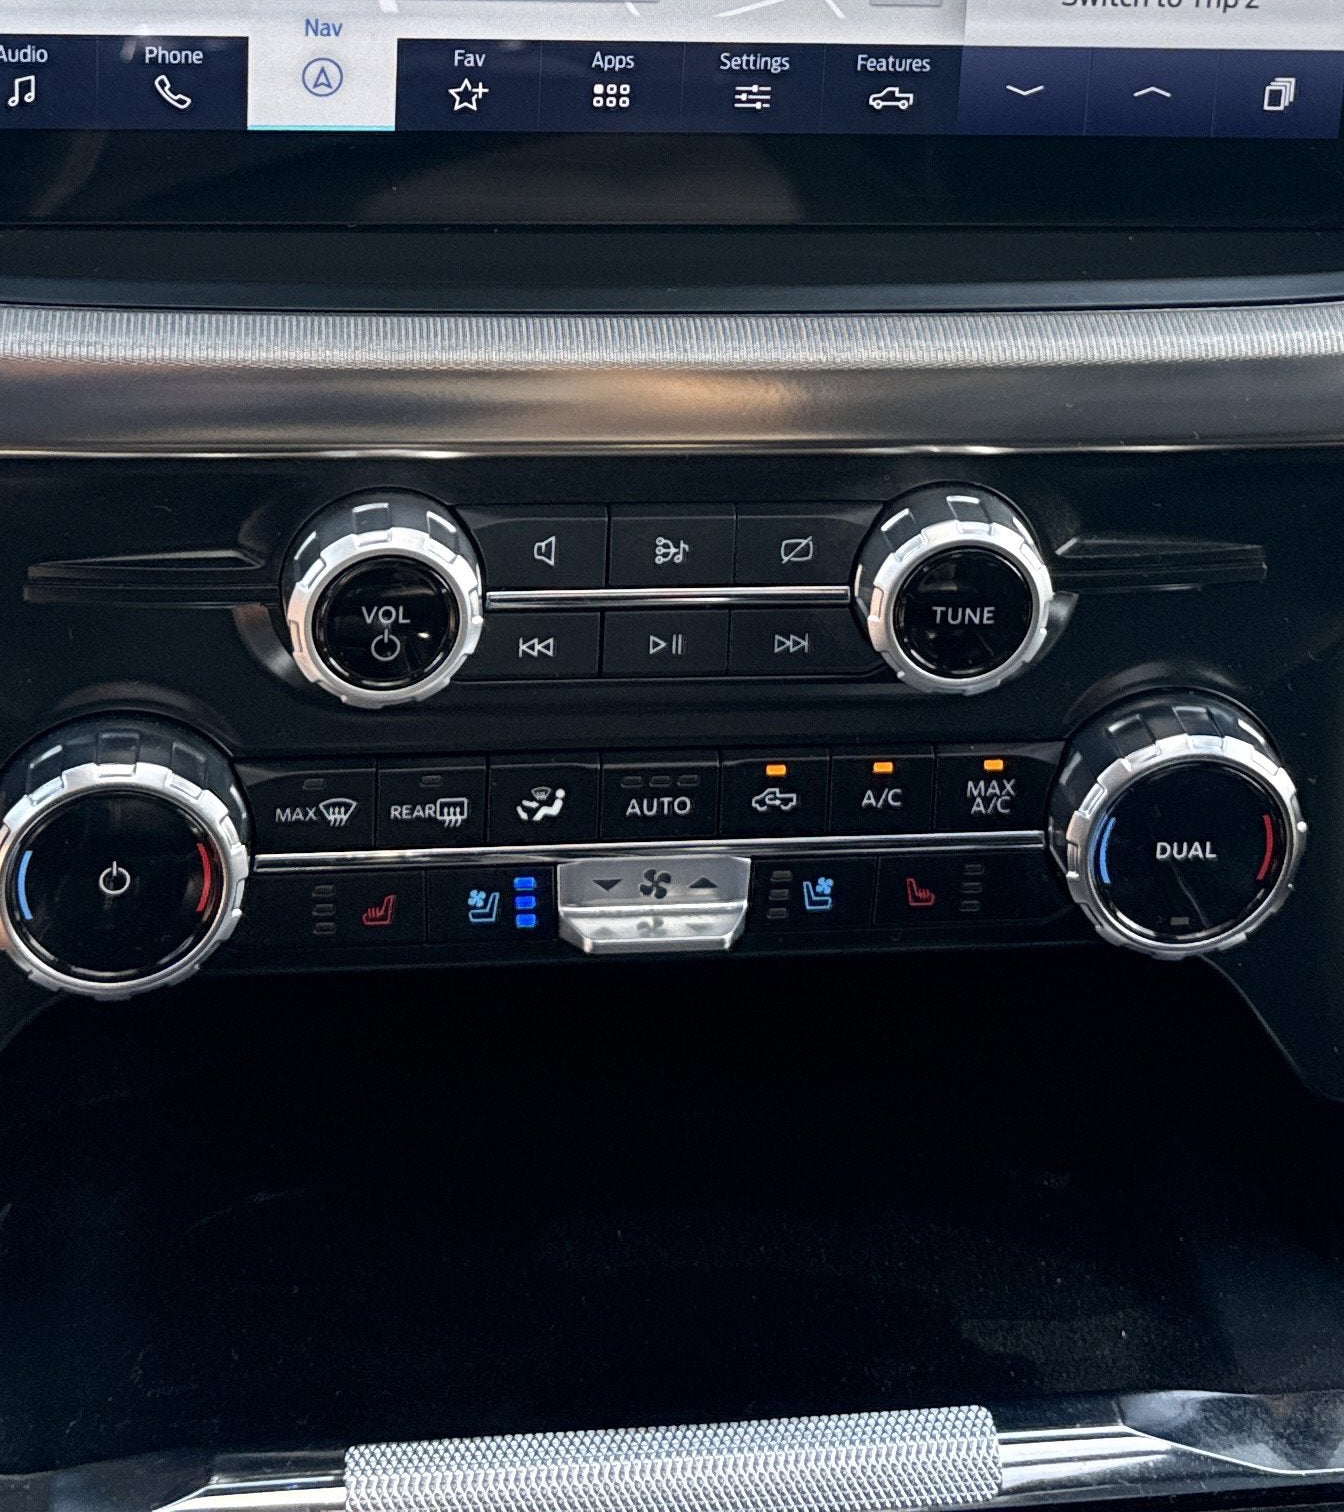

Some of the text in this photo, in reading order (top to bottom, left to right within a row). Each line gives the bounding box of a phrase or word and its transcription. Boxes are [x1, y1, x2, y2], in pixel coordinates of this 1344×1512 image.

[305, 18, 343, 37] Nav
[144, 45, 204, 65] Phone
[453, 49, 486, 69] Fav
[591, 50, 635, 72] Apps
[720, 52, 790, 74] Settings
[856, 54, 931, 74] Features
[361, 605, 411, 624] VOL
[932, 606, 996, 625] TUNE
[861, 788, 902, 808] A/C
[967, 779, 1015, 797] MAX
[275, 805, 317, 823] MAX
[390, 803, 435, 821] REAR
[626, 797, 691, 817] AUTO
[970, 795, 1011, 815] A/C
[1155, 840, 1217, 860] DUAL
